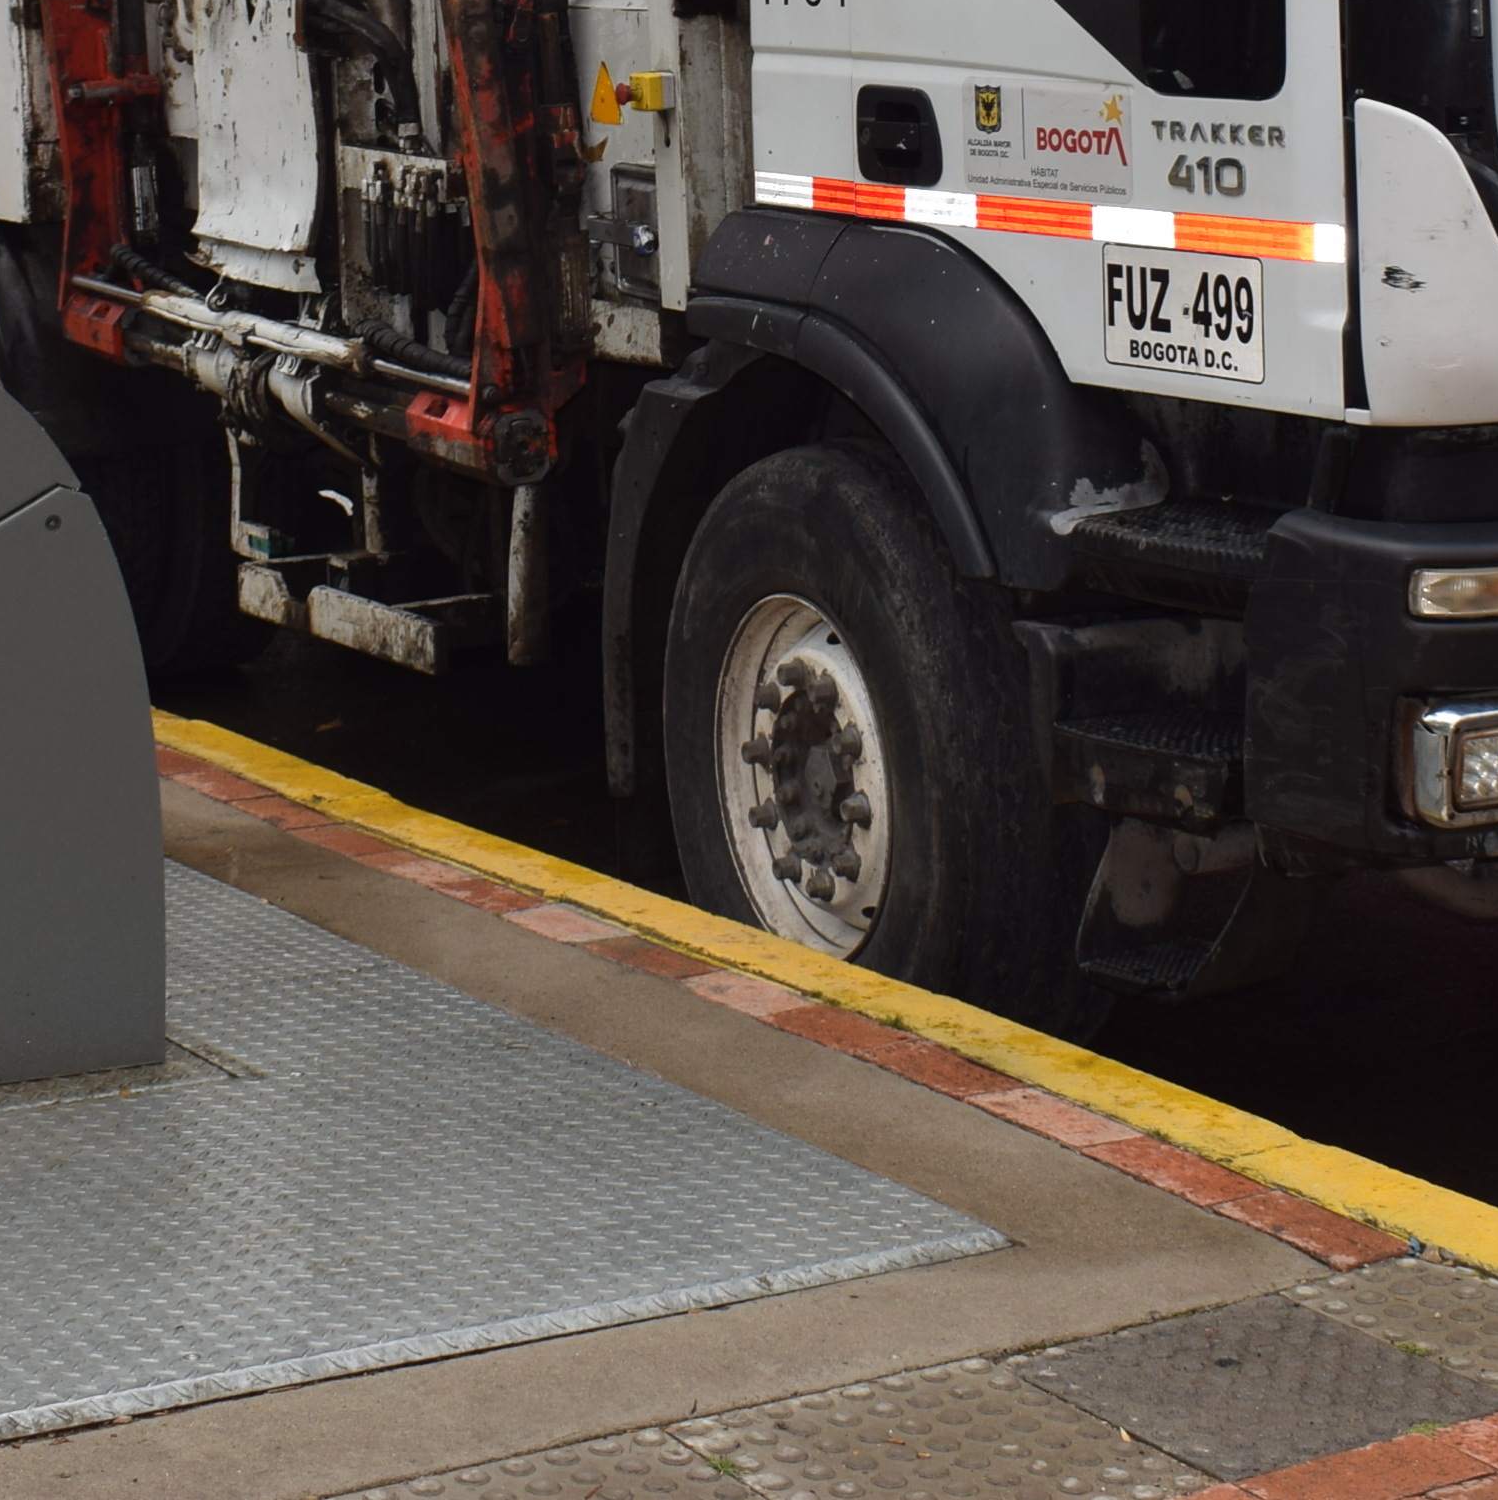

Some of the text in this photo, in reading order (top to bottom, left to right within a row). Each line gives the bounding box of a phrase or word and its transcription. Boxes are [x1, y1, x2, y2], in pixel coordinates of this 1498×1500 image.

[1151, 120, 1286, 148] TRAKKER
[968, 174, 989, 184] Unidad
[990, 175, 1031, 187] Administrativa
[1033, 179, 1059, 190] Especial
[1060, 180, 1068, 189] de
[1069, 181, 1098, 193] Servicios
[1168, 154, 1247, 197] 410
[1107, 263, 1254, 344] FUZ 499
[1129, 339, 1239, 371] BOGOTA D.C.
